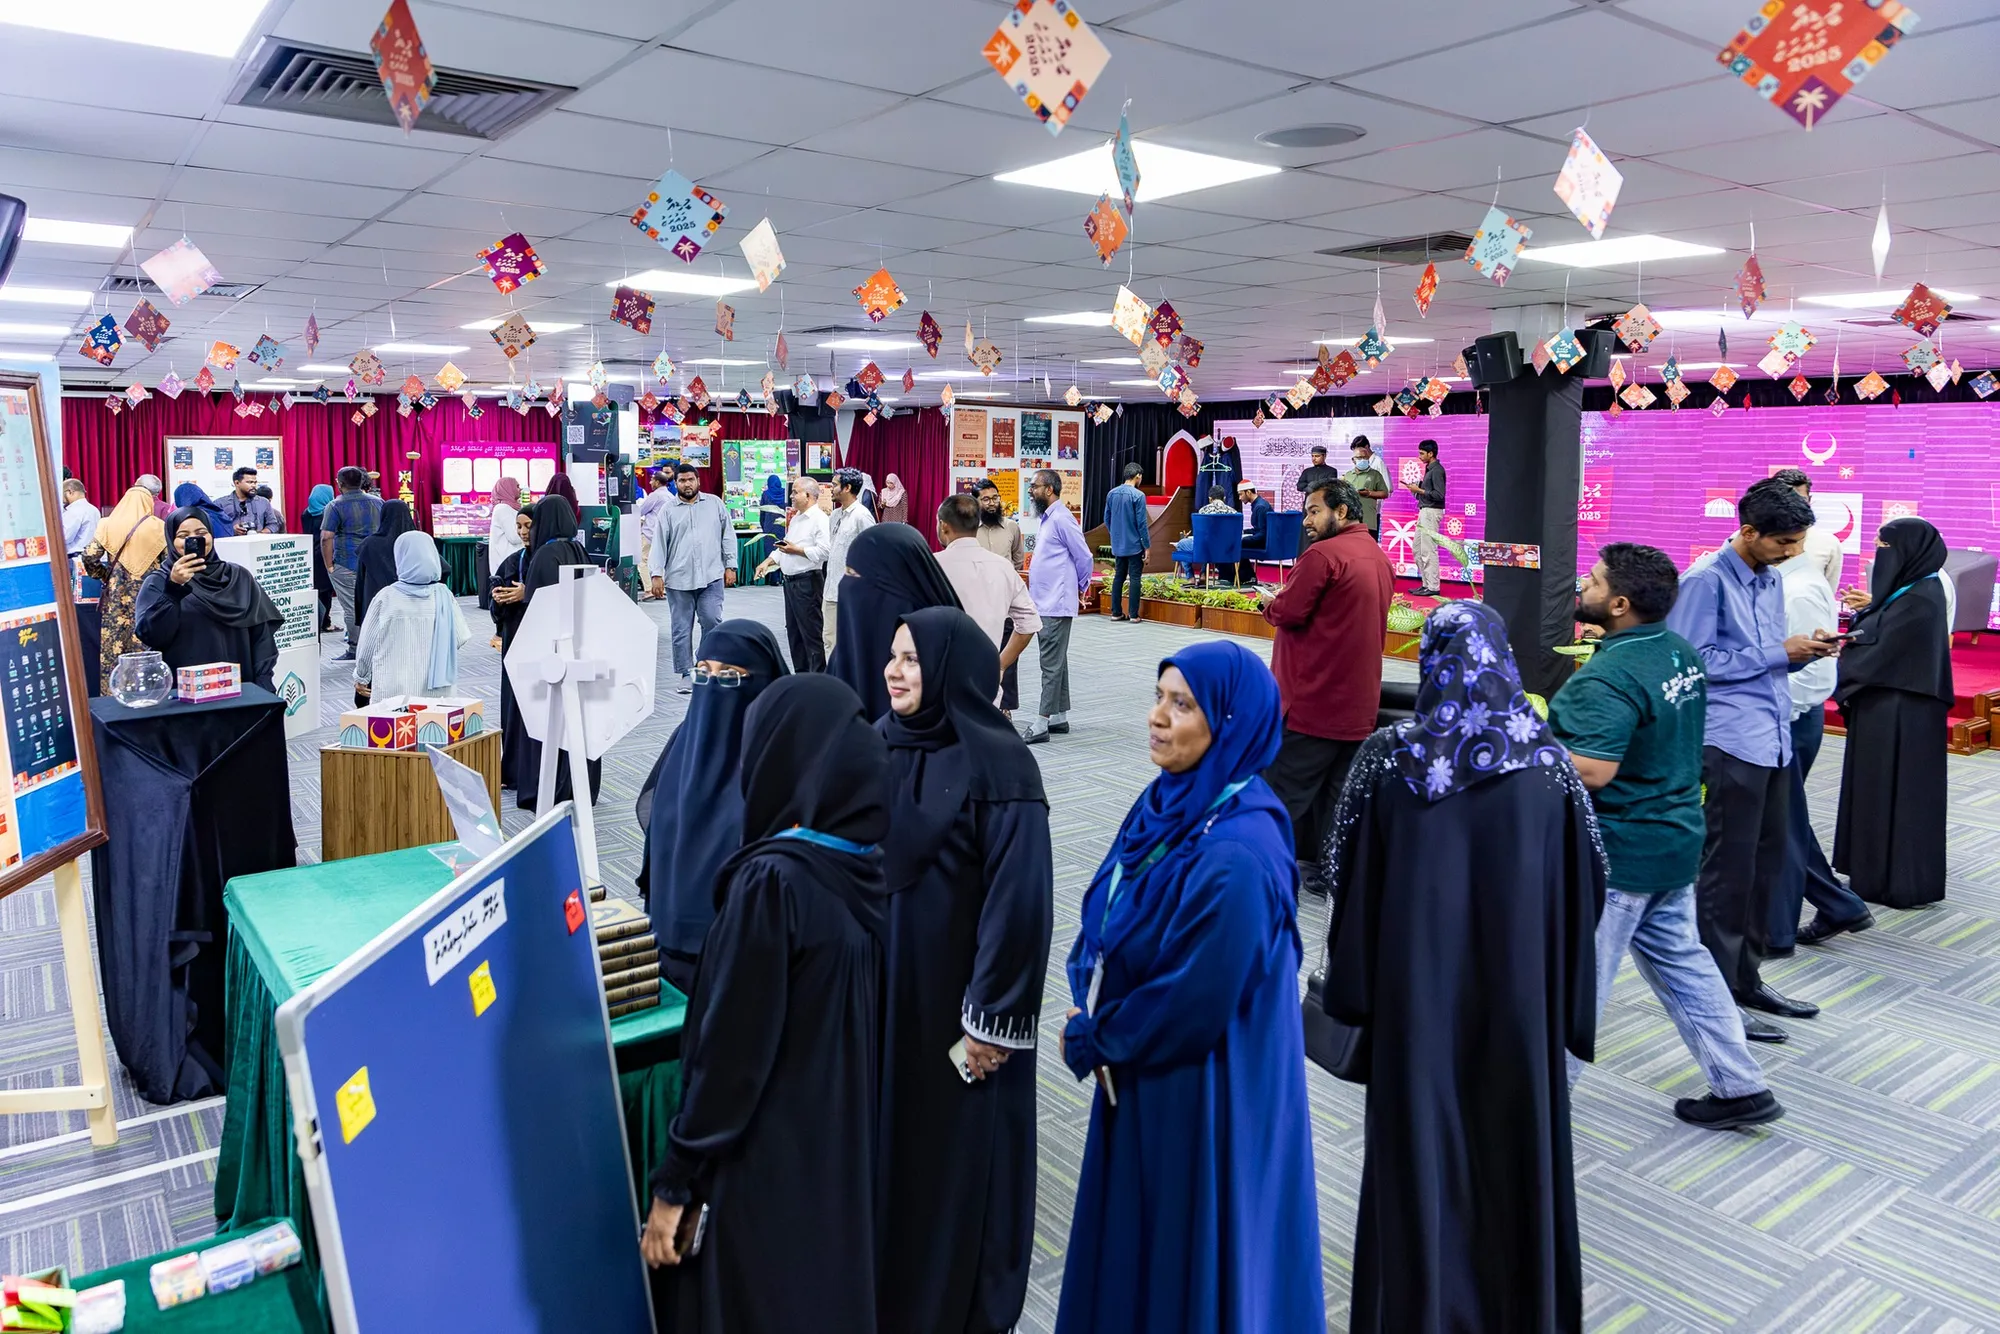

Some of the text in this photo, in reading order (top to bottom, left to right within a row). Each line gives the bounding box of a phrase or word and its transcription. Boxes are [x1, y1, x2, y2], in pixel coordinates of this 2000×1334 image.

[1787, 46, 1842, 72] 2025
[670, 220, 696, 232] 2025
[1490, 249, 1508, 262] 2025
[500, 266, 520, 274] 2025
[630, 309, 644, 320] 2025
[1916, 312, 1934, 320] 2025
[270, 541, 295, 551] MISSION
